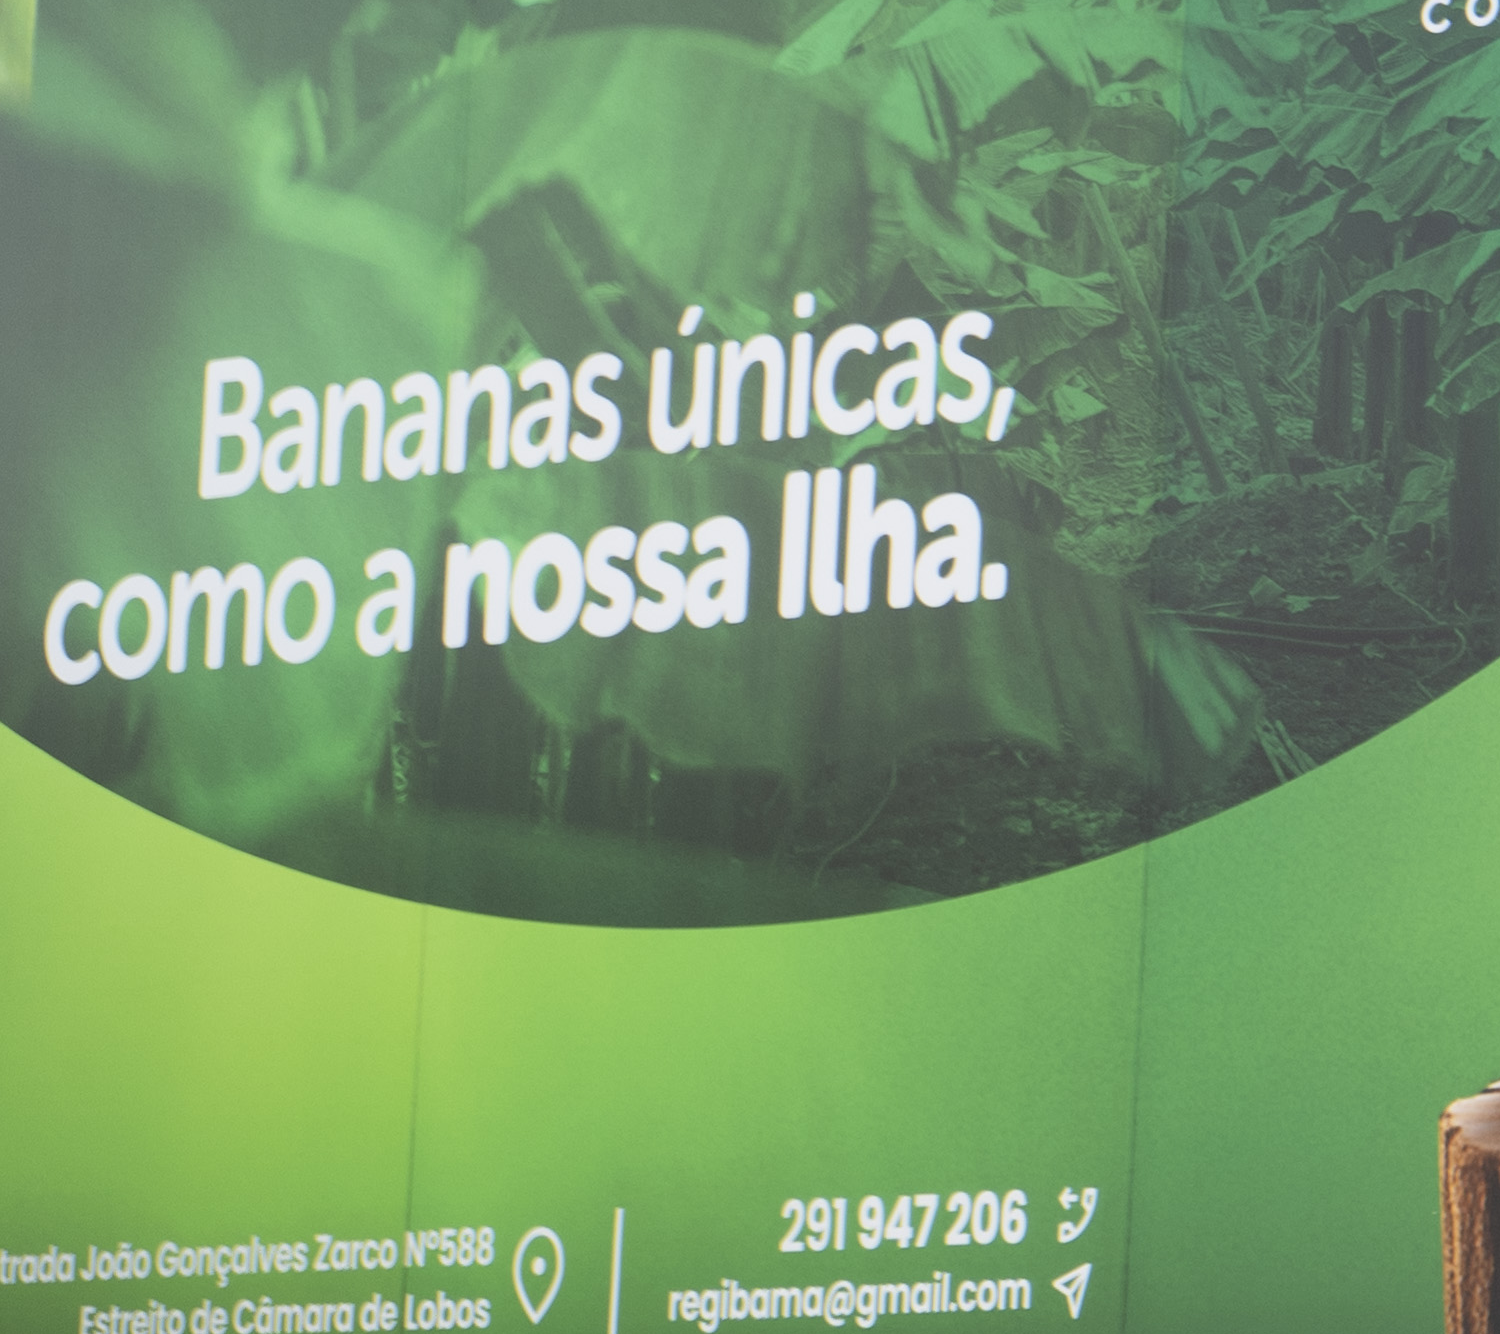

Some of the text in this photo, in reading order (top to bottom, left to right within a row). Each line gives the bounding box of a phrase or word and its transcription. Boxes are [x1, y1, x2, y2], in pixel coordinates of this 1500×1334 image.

[196, 291, 1018, 501] Bananas únicas,
[43, 464, 1010, 686] como a nossa Ilha.
[778, 1188, 1029, 1254] 291 947 206
[80, 1240, 152, 1281] João
[155, 1234, 309, 1288] Gonçalves
[313, 1232, 398, 1273] Zarco
[359, 1292, 398, 1332] de
[404, 1290, 491, 1331] Lobos
[667, 1269, 1032, 1334] regibama@gmail.com
